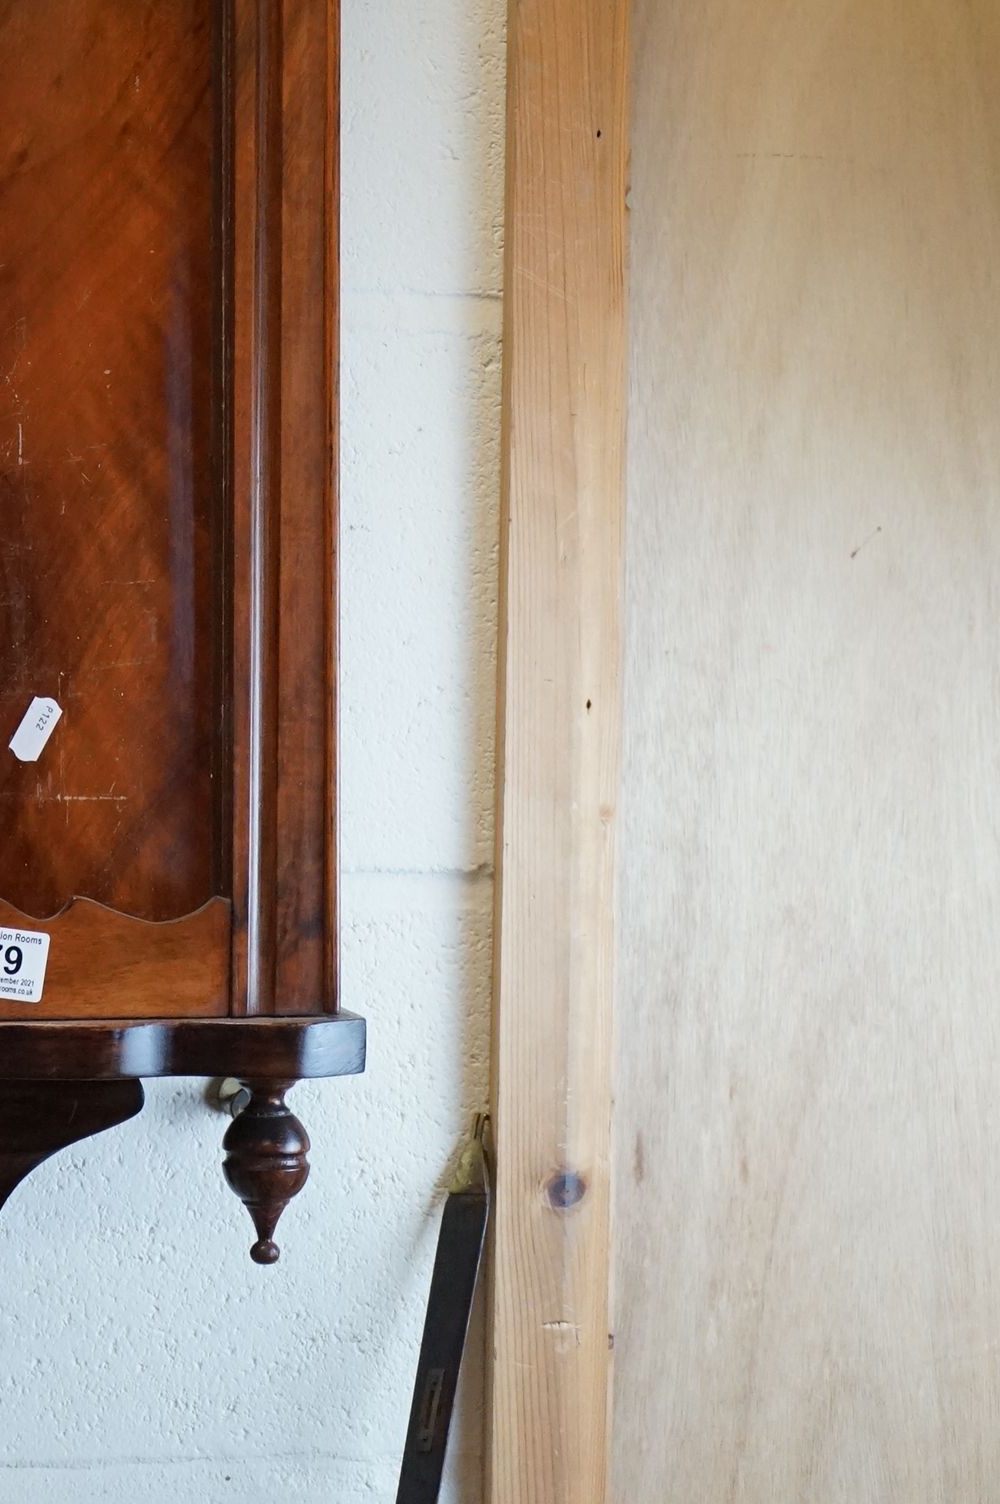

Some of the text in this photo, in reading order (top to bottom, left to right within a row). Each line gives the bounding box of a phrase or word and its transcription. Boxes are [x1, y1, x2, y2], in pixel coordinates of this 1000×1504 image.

[35, 705, 54, 731] P122
[15, 933, 43, 945] Rooms
[20, 978, 35, 987] 2021
